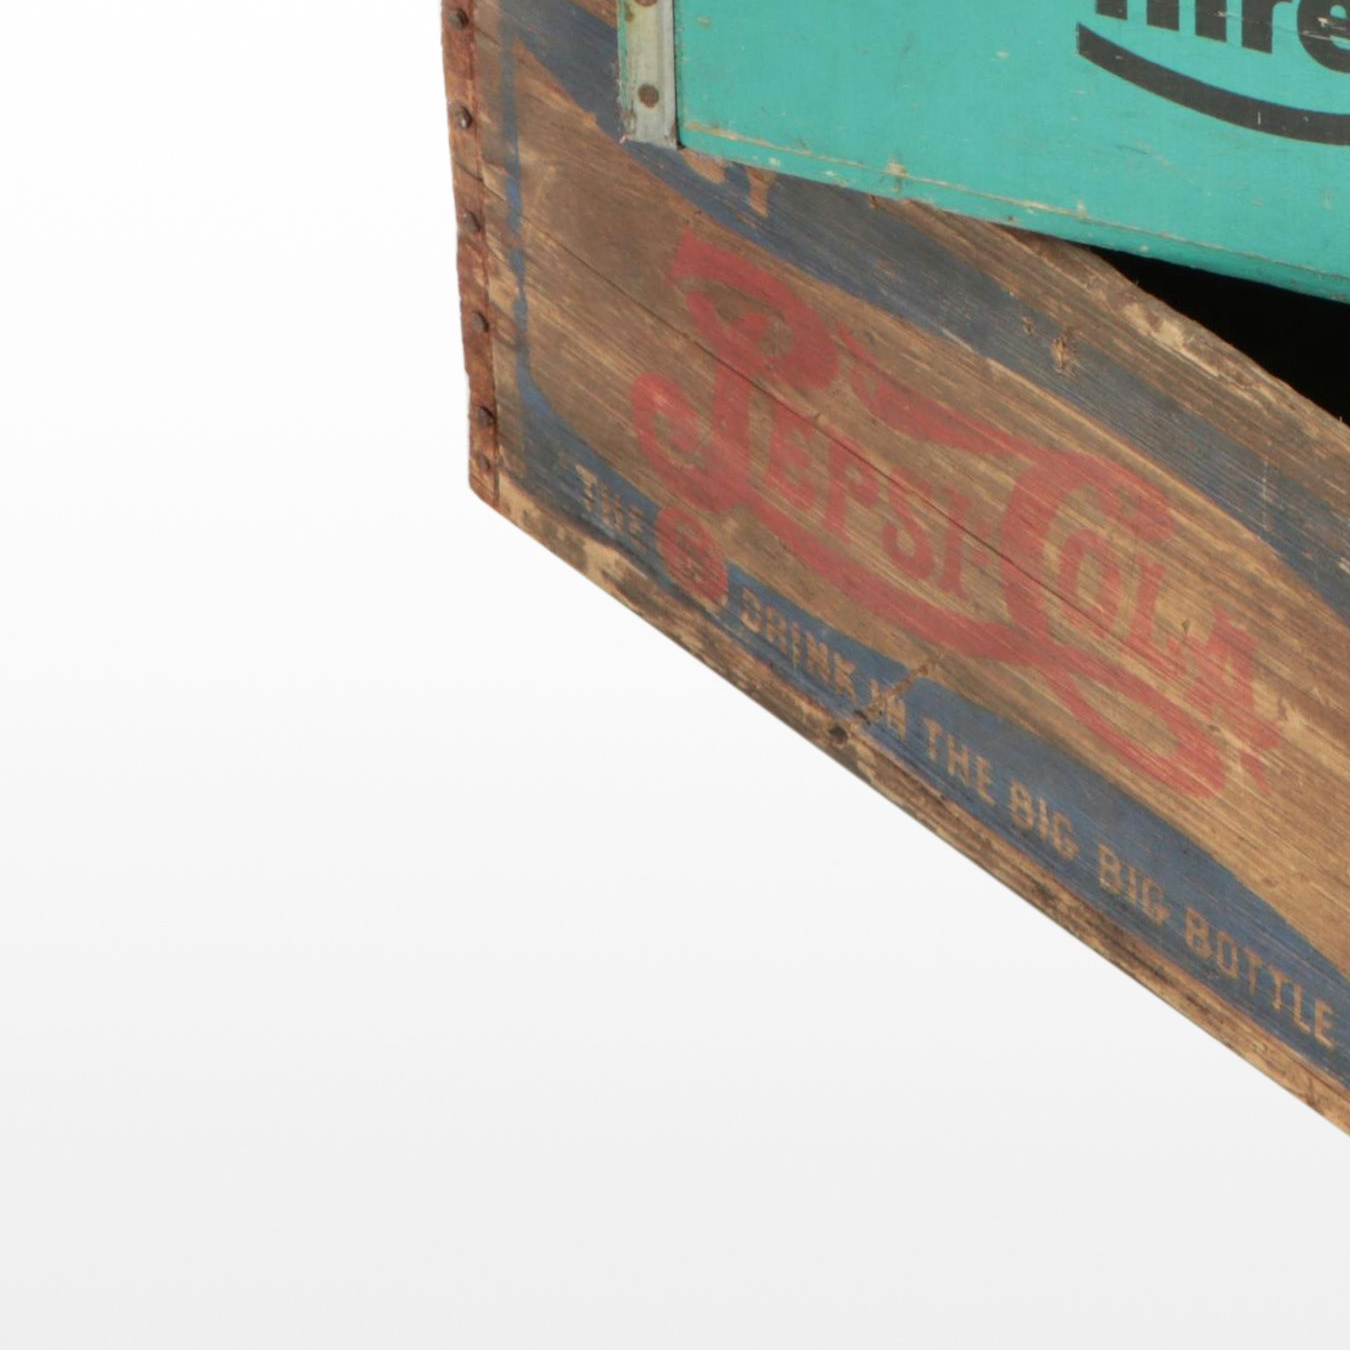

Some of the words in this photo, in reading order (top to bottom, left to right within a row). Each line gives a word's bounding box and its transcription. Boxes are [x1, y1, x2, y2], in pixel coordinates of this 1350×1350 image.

[741, 587, 857, 706] DRINK
[922, 715, 996, 807] THE
[1098, 843, 1172, 927] BIG
[1184, 906, 1336, 1050] BOTTLE
